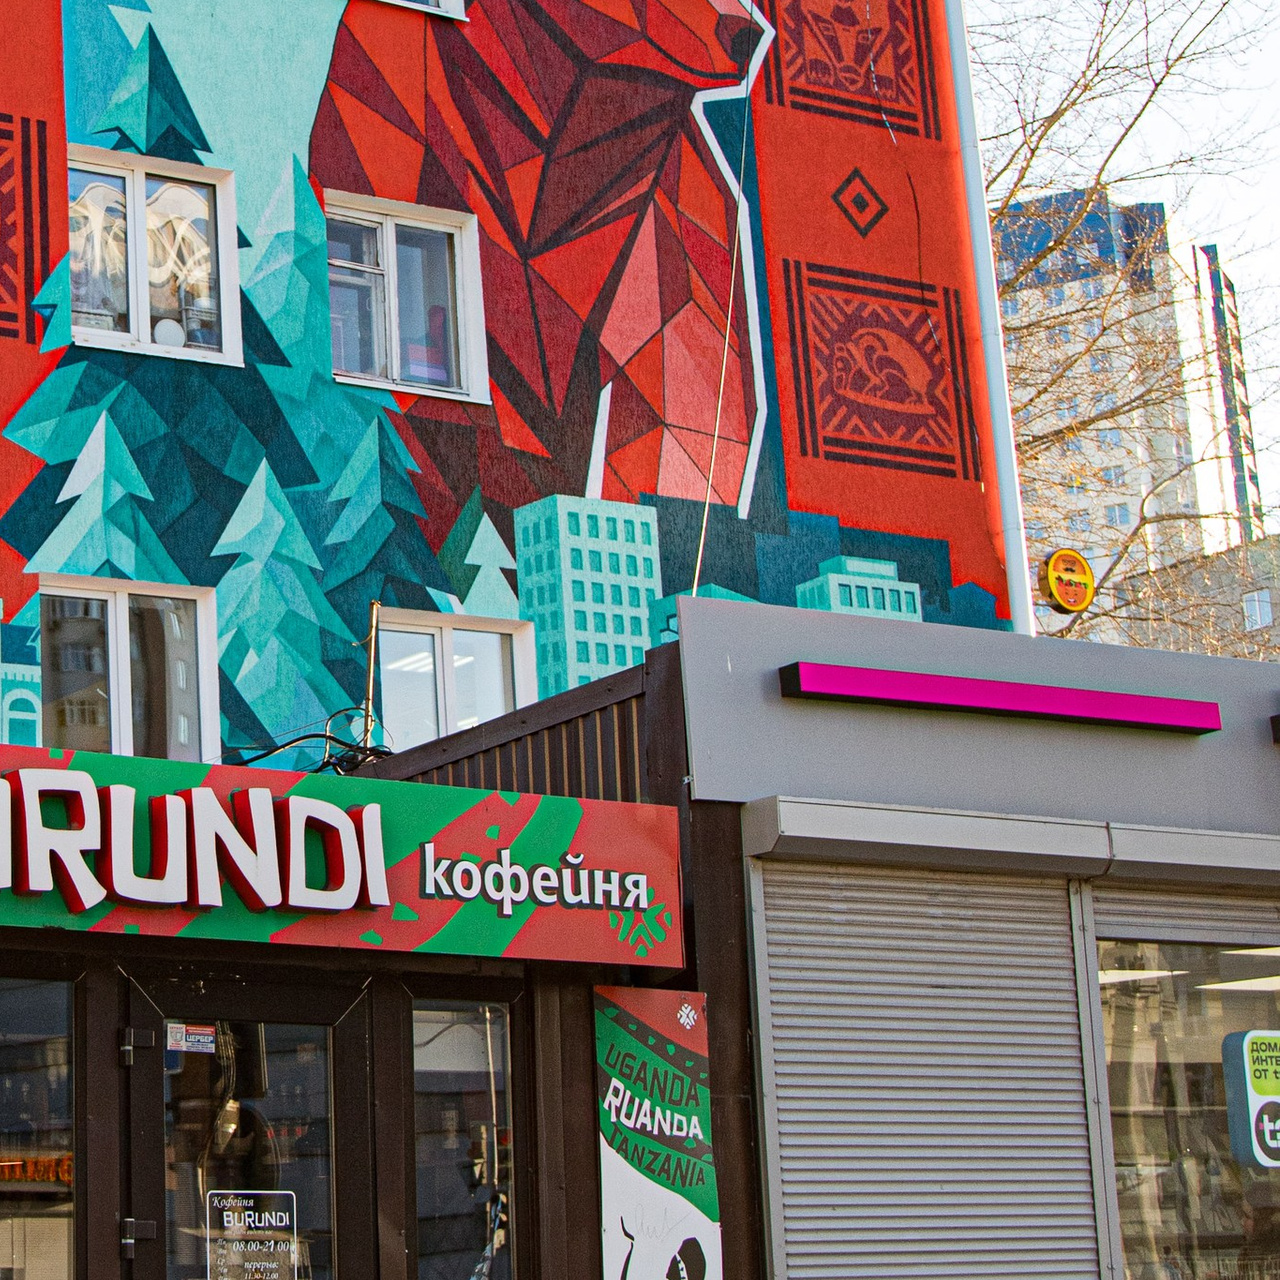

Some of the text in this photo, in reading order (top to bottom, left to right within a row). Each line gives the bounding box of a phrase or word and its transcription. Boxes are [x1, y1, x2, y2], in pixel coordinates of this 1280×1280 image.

[420, 840, 648, 914] кофейня
[604, 1042, 700, 1108] UGANDA
[1253, 1069, 1268, 1080] ОТ
[603, 1077, 704, 1140] RUANDA
[608, 1121, 706, 1189] TANZANIA
[212, 1195, 254, 1209] Кофейня
[223, 1211, 289, 1227] BURUNDI
